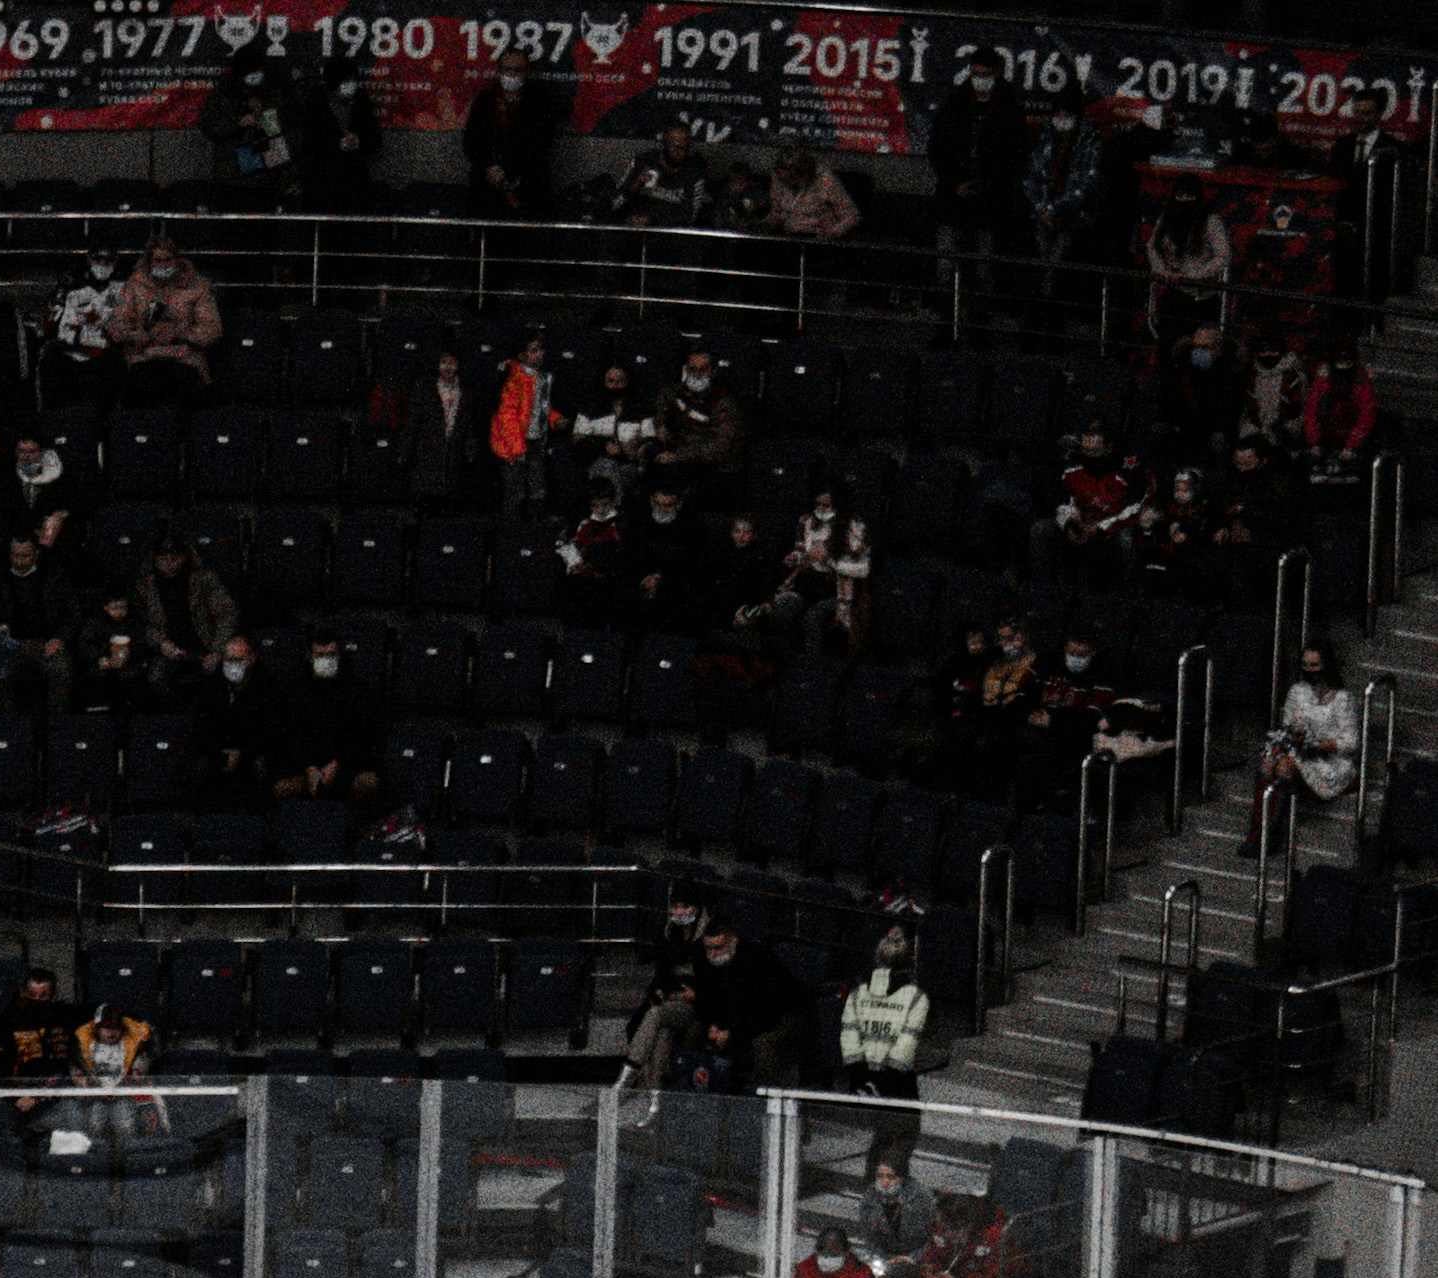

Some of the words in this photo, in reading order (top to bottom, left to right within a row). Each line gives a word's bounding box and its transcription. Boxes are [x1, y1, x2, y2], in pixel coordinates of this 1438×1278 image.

[94, 16, 205, 59] 1977
[314, 16, 434, 59] 1980
[459, 20, 572, 61] 1987
[654, 25, 761, 72] 1991
[783, 32, 901, 81] 2015
[1116, 57, 1227, 101] 2019
